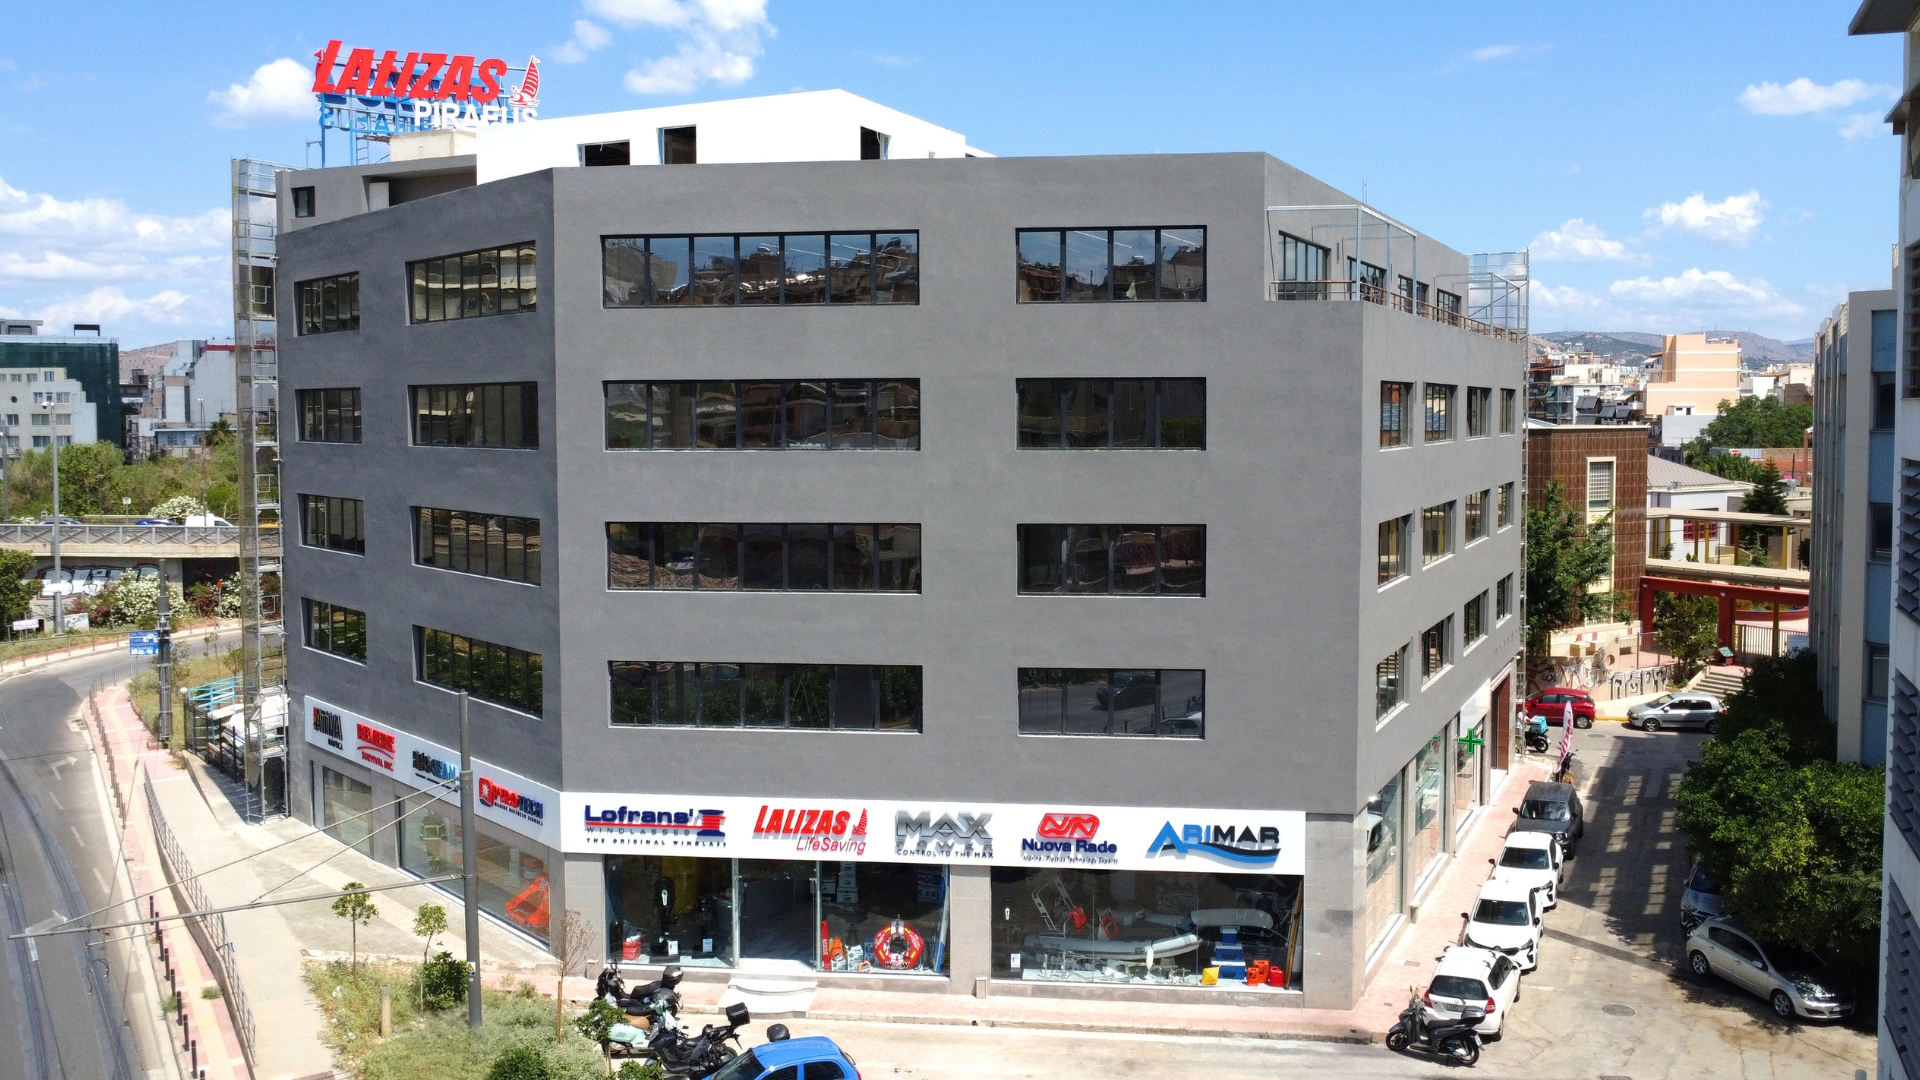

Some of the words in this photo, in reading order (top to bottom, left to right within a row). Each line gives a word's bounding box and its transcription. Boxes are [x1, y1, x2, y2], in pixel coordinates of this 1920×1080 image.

[312, 39, 508, 103] LALIZAS
[414, 101, 538, 130] PIRAEUS
[586, 826, 690, 836] WINDLASSES
[753, 804, 851, 836] LALIZAS
[895, 810, 994, 839] MAX
[796, 837, 867, 856] LifeSaving
[895, 840, 993, 851] POWER
[1022, 838, 1072, 852] Nuova
[1075, 839, 1118, 853] Rade
[1146, 820, 1280, 854] ARIMAR
[896, 849, 937, 857] CONTROL
